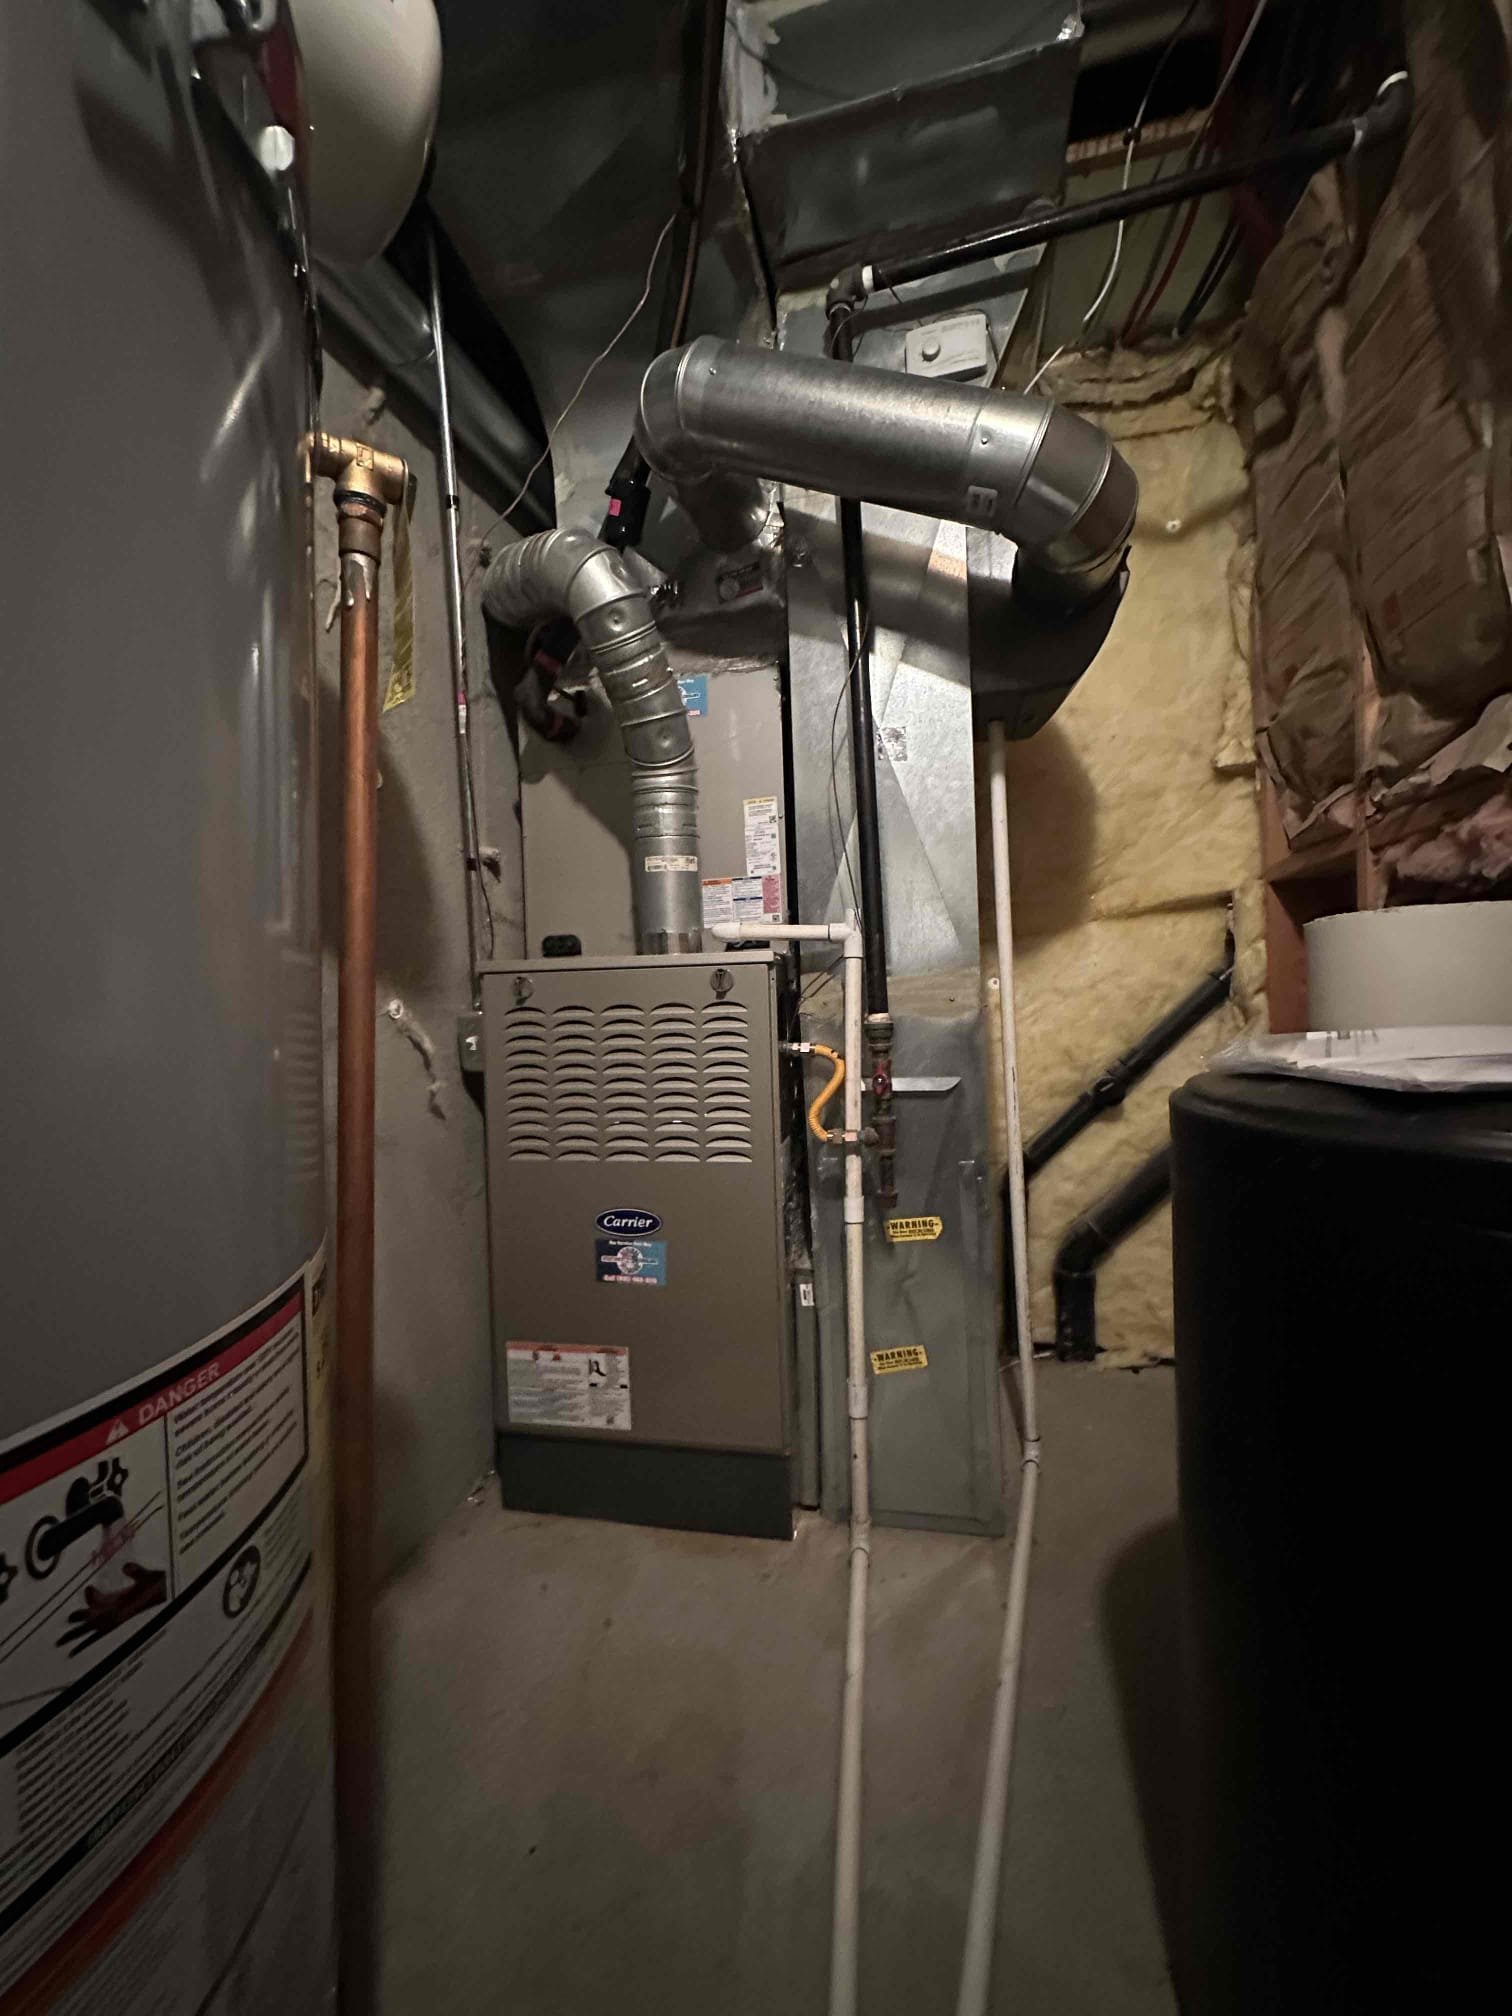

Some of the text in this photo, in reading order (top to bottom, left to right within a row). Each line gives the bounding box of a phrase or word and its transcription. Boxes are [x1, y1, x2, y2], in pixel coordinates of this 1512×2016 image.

[603, 1215, 653, 1228] Carrier
[890, 1220, 934, 1230] WARNING
[877, 1348, 919, 1362] WARNING
[138, 1362, 221, 1427] DANGER
